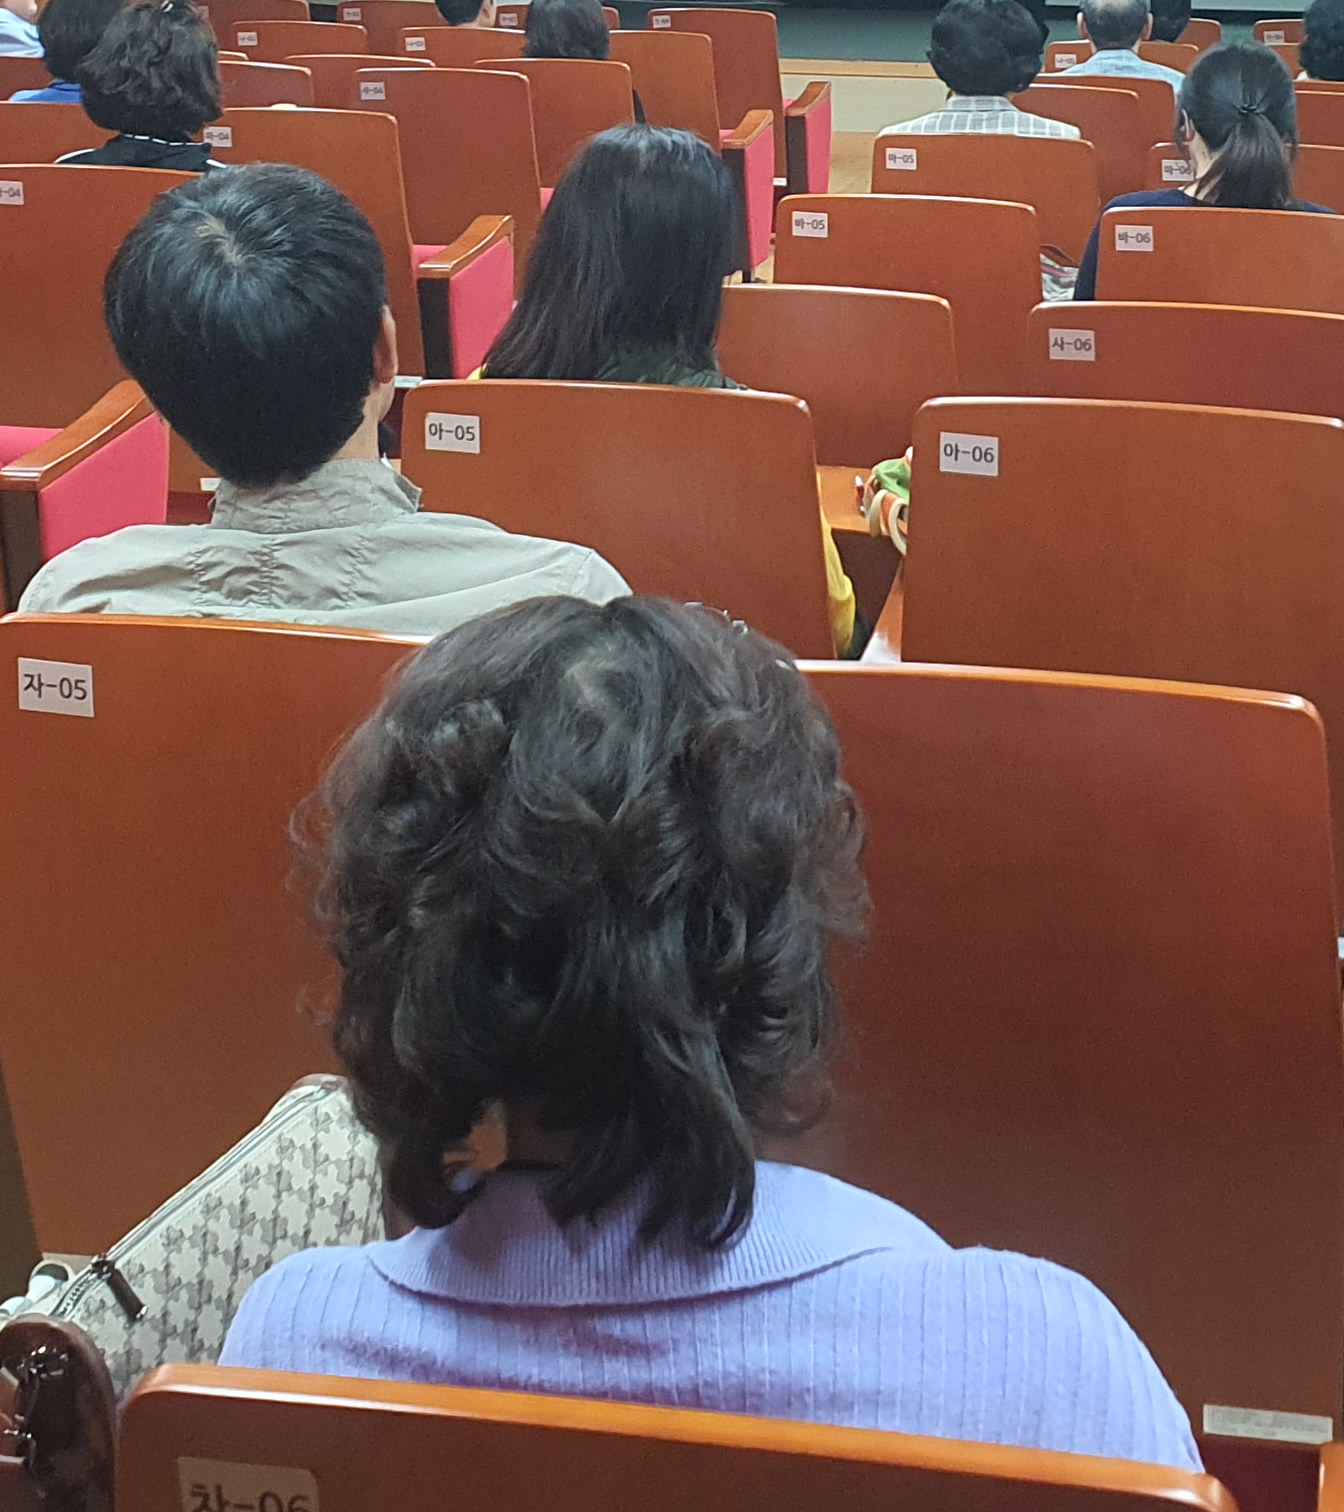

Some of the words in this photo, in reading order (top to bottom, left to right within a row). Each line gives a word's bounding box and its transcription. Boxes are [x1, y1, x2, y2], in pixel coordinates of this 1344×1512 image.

[888, 153, 915, 164] 마-05
[794, 217, 825, 230] 바-05
[1117, 231, 1151, 244] 바-06
[1051, 337, 1093, 352] 사-06
[427, 422, 476, 442] 아-05
[942, 441, 995, 464] 아-06
[23, 673, 88, 701] 자-05
